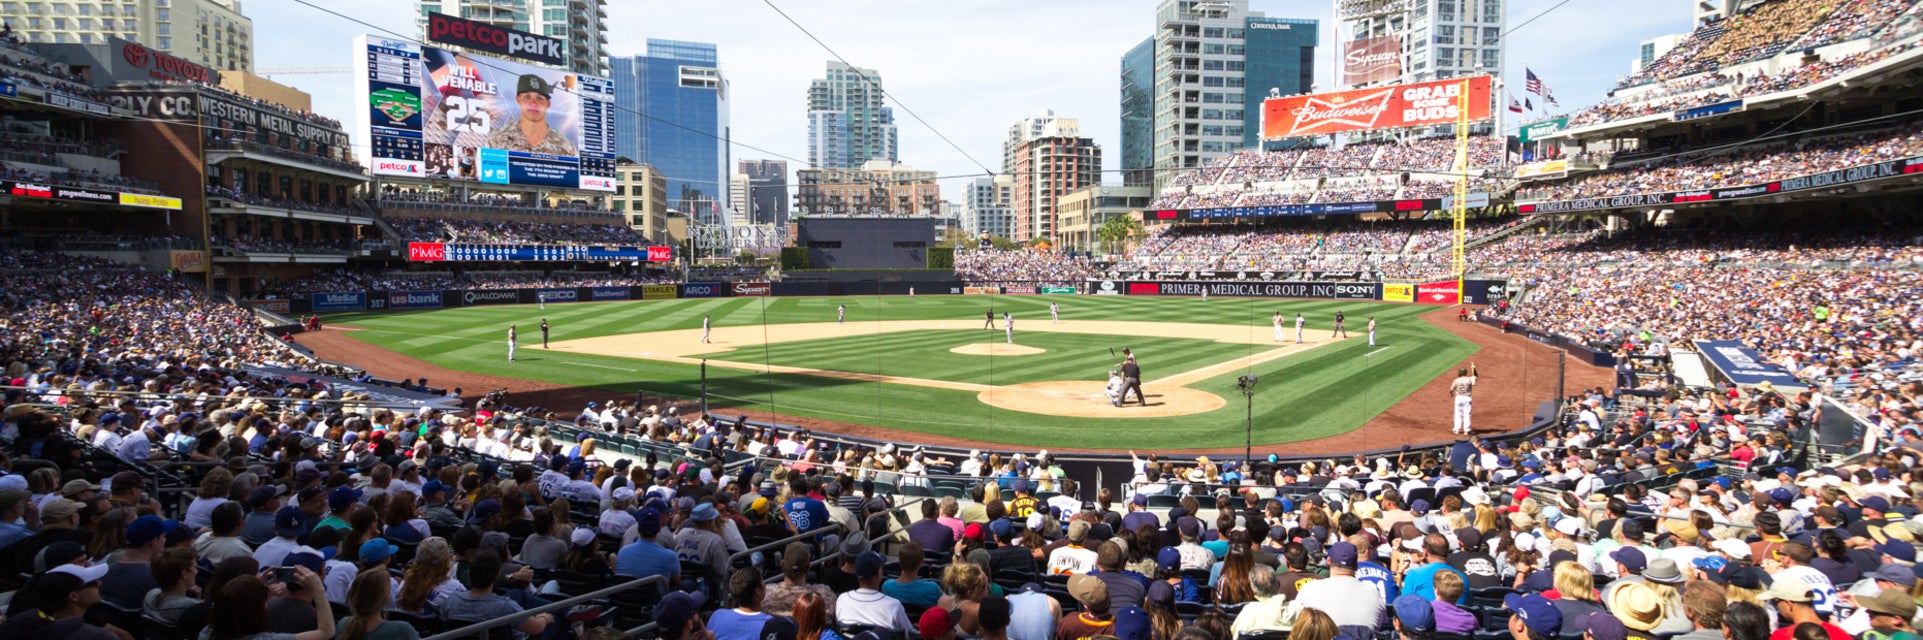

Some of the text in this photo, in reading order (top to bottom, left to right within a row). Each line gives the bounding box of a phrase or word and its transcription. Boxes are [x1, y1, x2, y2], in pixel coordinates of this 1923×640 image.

[1346, 49, 1396, 66] Sycuan
[152, 51, 211, 83] TOYOTA
[448, 63, 476, 79] WILL
[441, 75, 496, 94] VENABLE
[1403, 84, 1459, 102] GRAB
[160, 97, 196, 116] CO.
[1412, 98, 1450, 108] SOME
[446, 96, 490, 135] 25
[1292, 103, 1388, 122] Budweiser
[1403, 105, 1458, 122] BUDS
[200, 96, 350, 148] WESTERN METAL SUPPLY CO.
[1781, 181, 1811, 191] PRIMERA
[1811, 173, 1845, 187] MEDICAL
[1879, 162, 1898, 176] INC.
[59, 190, 112, 200] pmgwellness.com
[1718, 187, 1766, 198] pmgwellness.com
[1535, 202, 1569, 212] PRIMERA
[1572, 199, 1609, 209] MEDICAL
[1612, 196, 1644, 207] GROUP,
[1648, 194, 1666, 204] INC.
[464, 292, 516, 304] QUALCOMM
[538, 290, 575, 299] GEICO
[1211, 284, 1262, 295] MEDICAL
[1265, 284, 1308, 298] GROUP,
[1312, 284, 1334, 297] INC
[370, 300, 385, 308] 357
[1056, 555, 1082, 570] GWYNN
